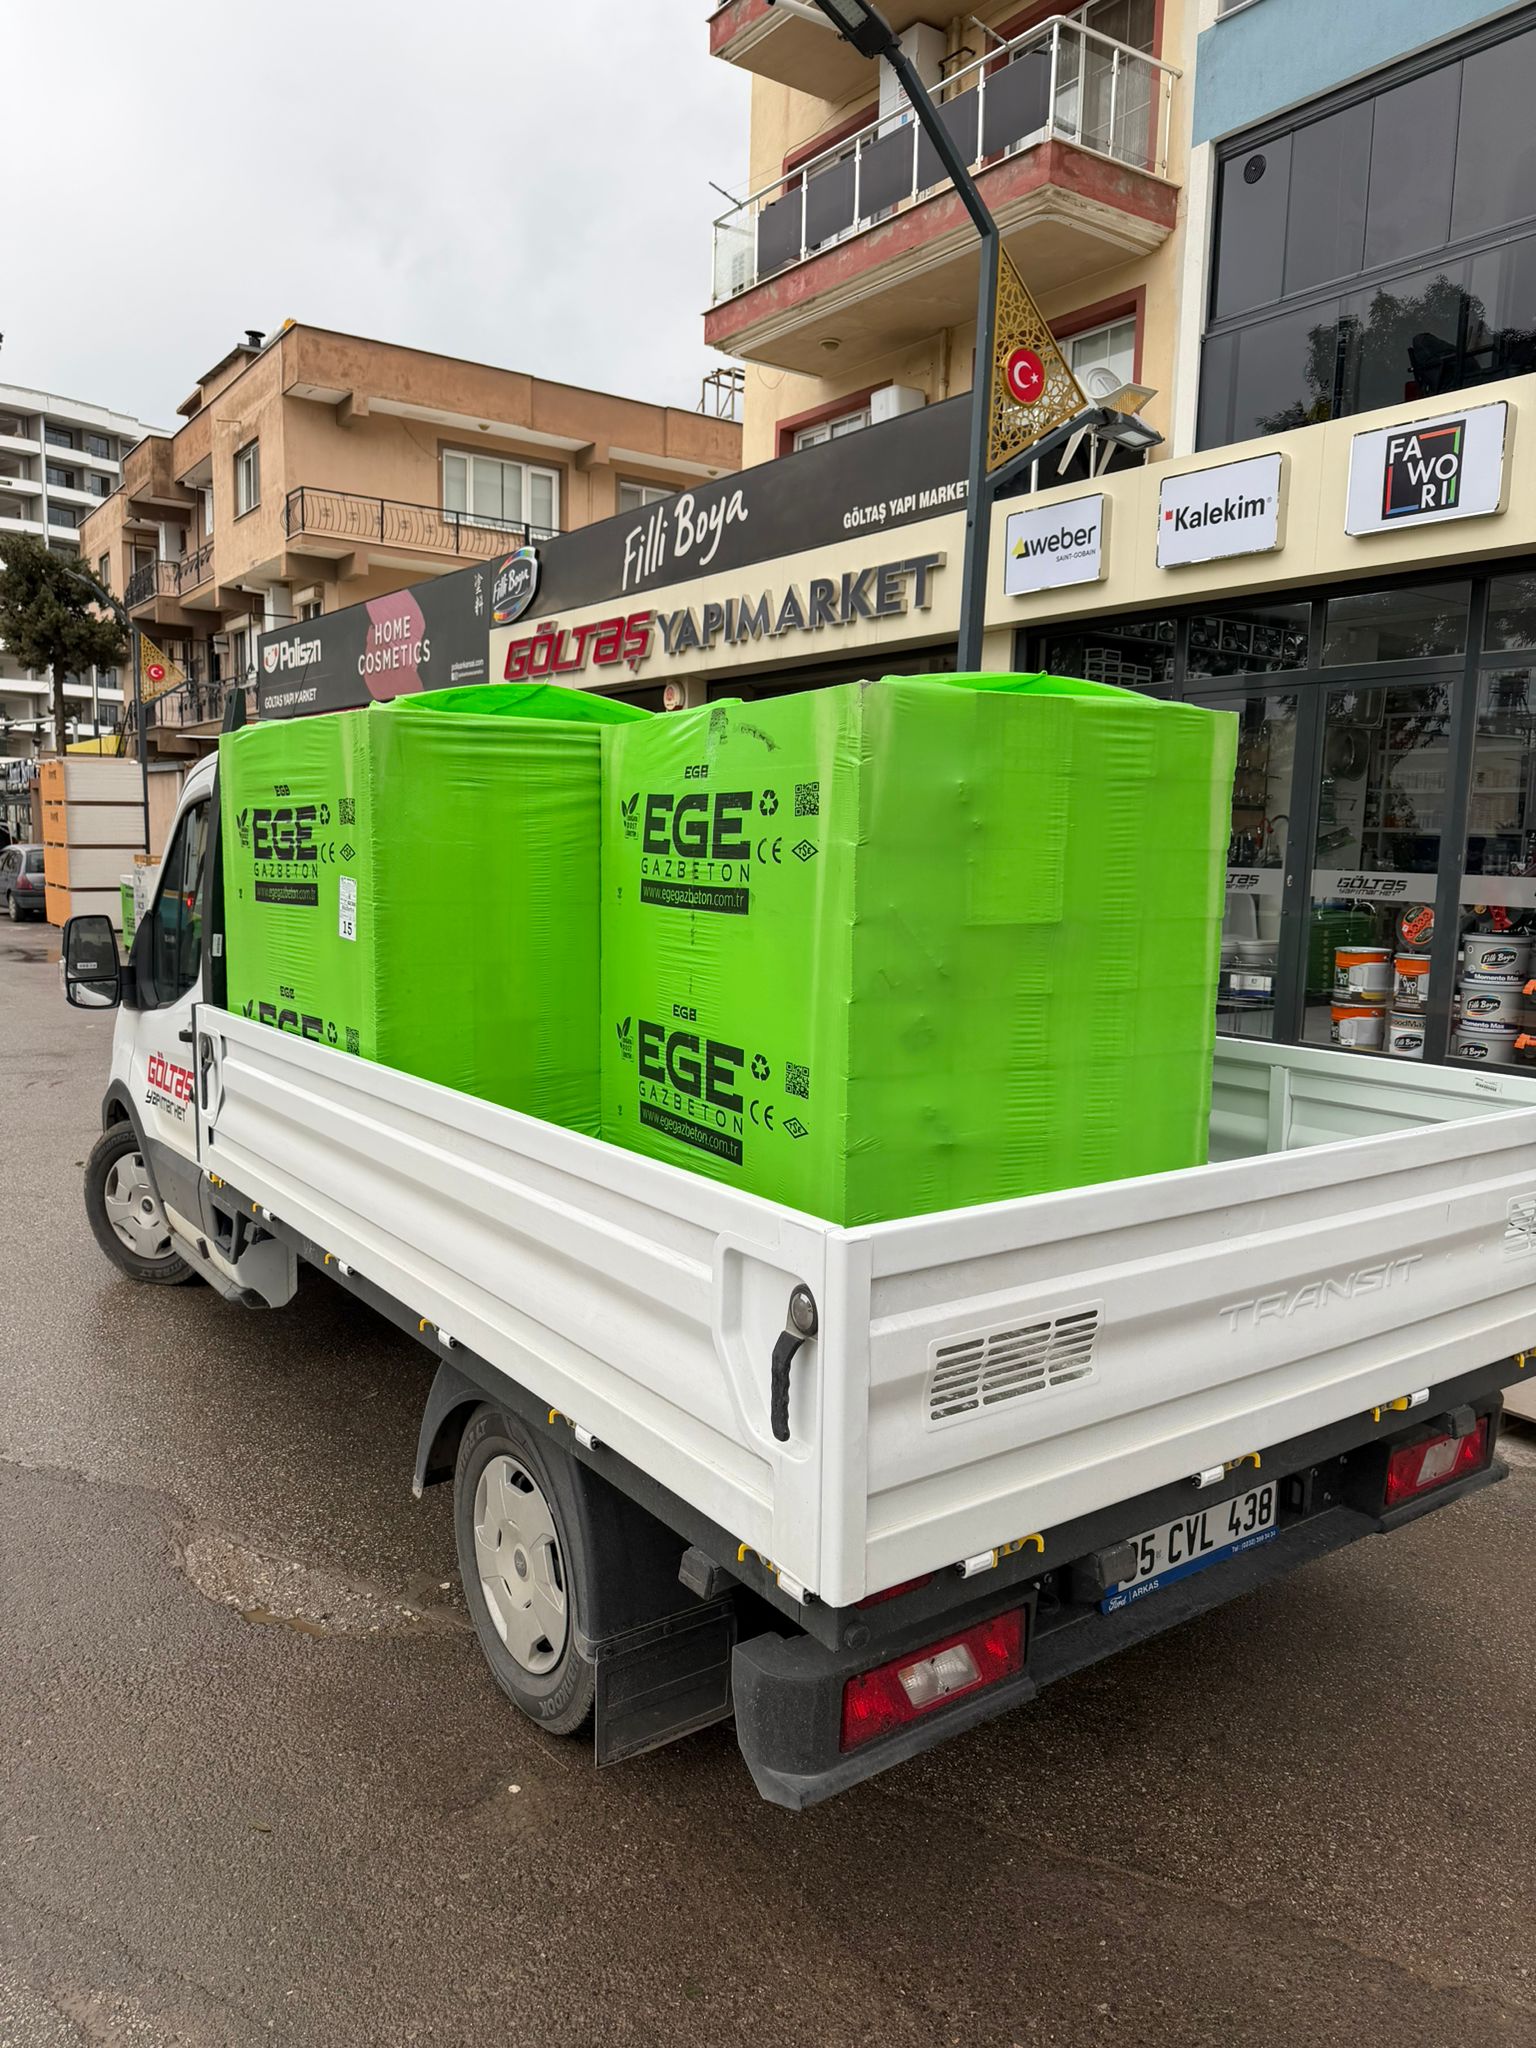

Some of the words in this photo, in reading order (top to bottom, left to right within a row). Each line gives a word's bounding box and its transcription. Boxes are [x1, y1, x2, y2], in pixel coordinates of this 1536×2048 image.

[843, 502, 887, 529] GÖLTAŞ
[889, 494, 916, 517] YAPI
[919, 479, 969, 509] MARKET
[1174, 494, 1265, 532] Kalekim
[622, 506, 668, 592] Filli
[674, 489, 748, 566] Boya
[1029, 524, 1097, 556] weber
[1055, 549, 1097, 563] SAINT-GOBAIN
[492, 573, 508, 604] Filli
[507, 568, 530, 595] Boya
[656, 551, 948, 655] YAPIMARKET
[374, 615, 411, 642] HOME
[280, 638, 321, 672] Polisan
[357, 639, 431, 676] COSMETICS
[253, 805, 317, 861] EGE
[643, 791, 753, 860] EGE
[253, 862, 318, 878] GAZBETON
[641, 857, 750, 883] GAZBETON
[643, 887, 745, 909] www.egegazbeton.com.tr
[343, 920, 353, 936] 15
[638, 1019, 744, 1114] EGE
[638, 1081, 744, 1136] GAZBETON
[641, 1107, 739, 1157] www.egegazbeton.com.tr
[1219, 1253, 1424, 1333] TRANSIT
[1168, 1513, 1214, 1564] CVL
[1228, 1487, 1273, 1537] 438
[1108, 1596, 1127, 1612] Ford
[1132, 1580, 1159, 1600] ARKAS
